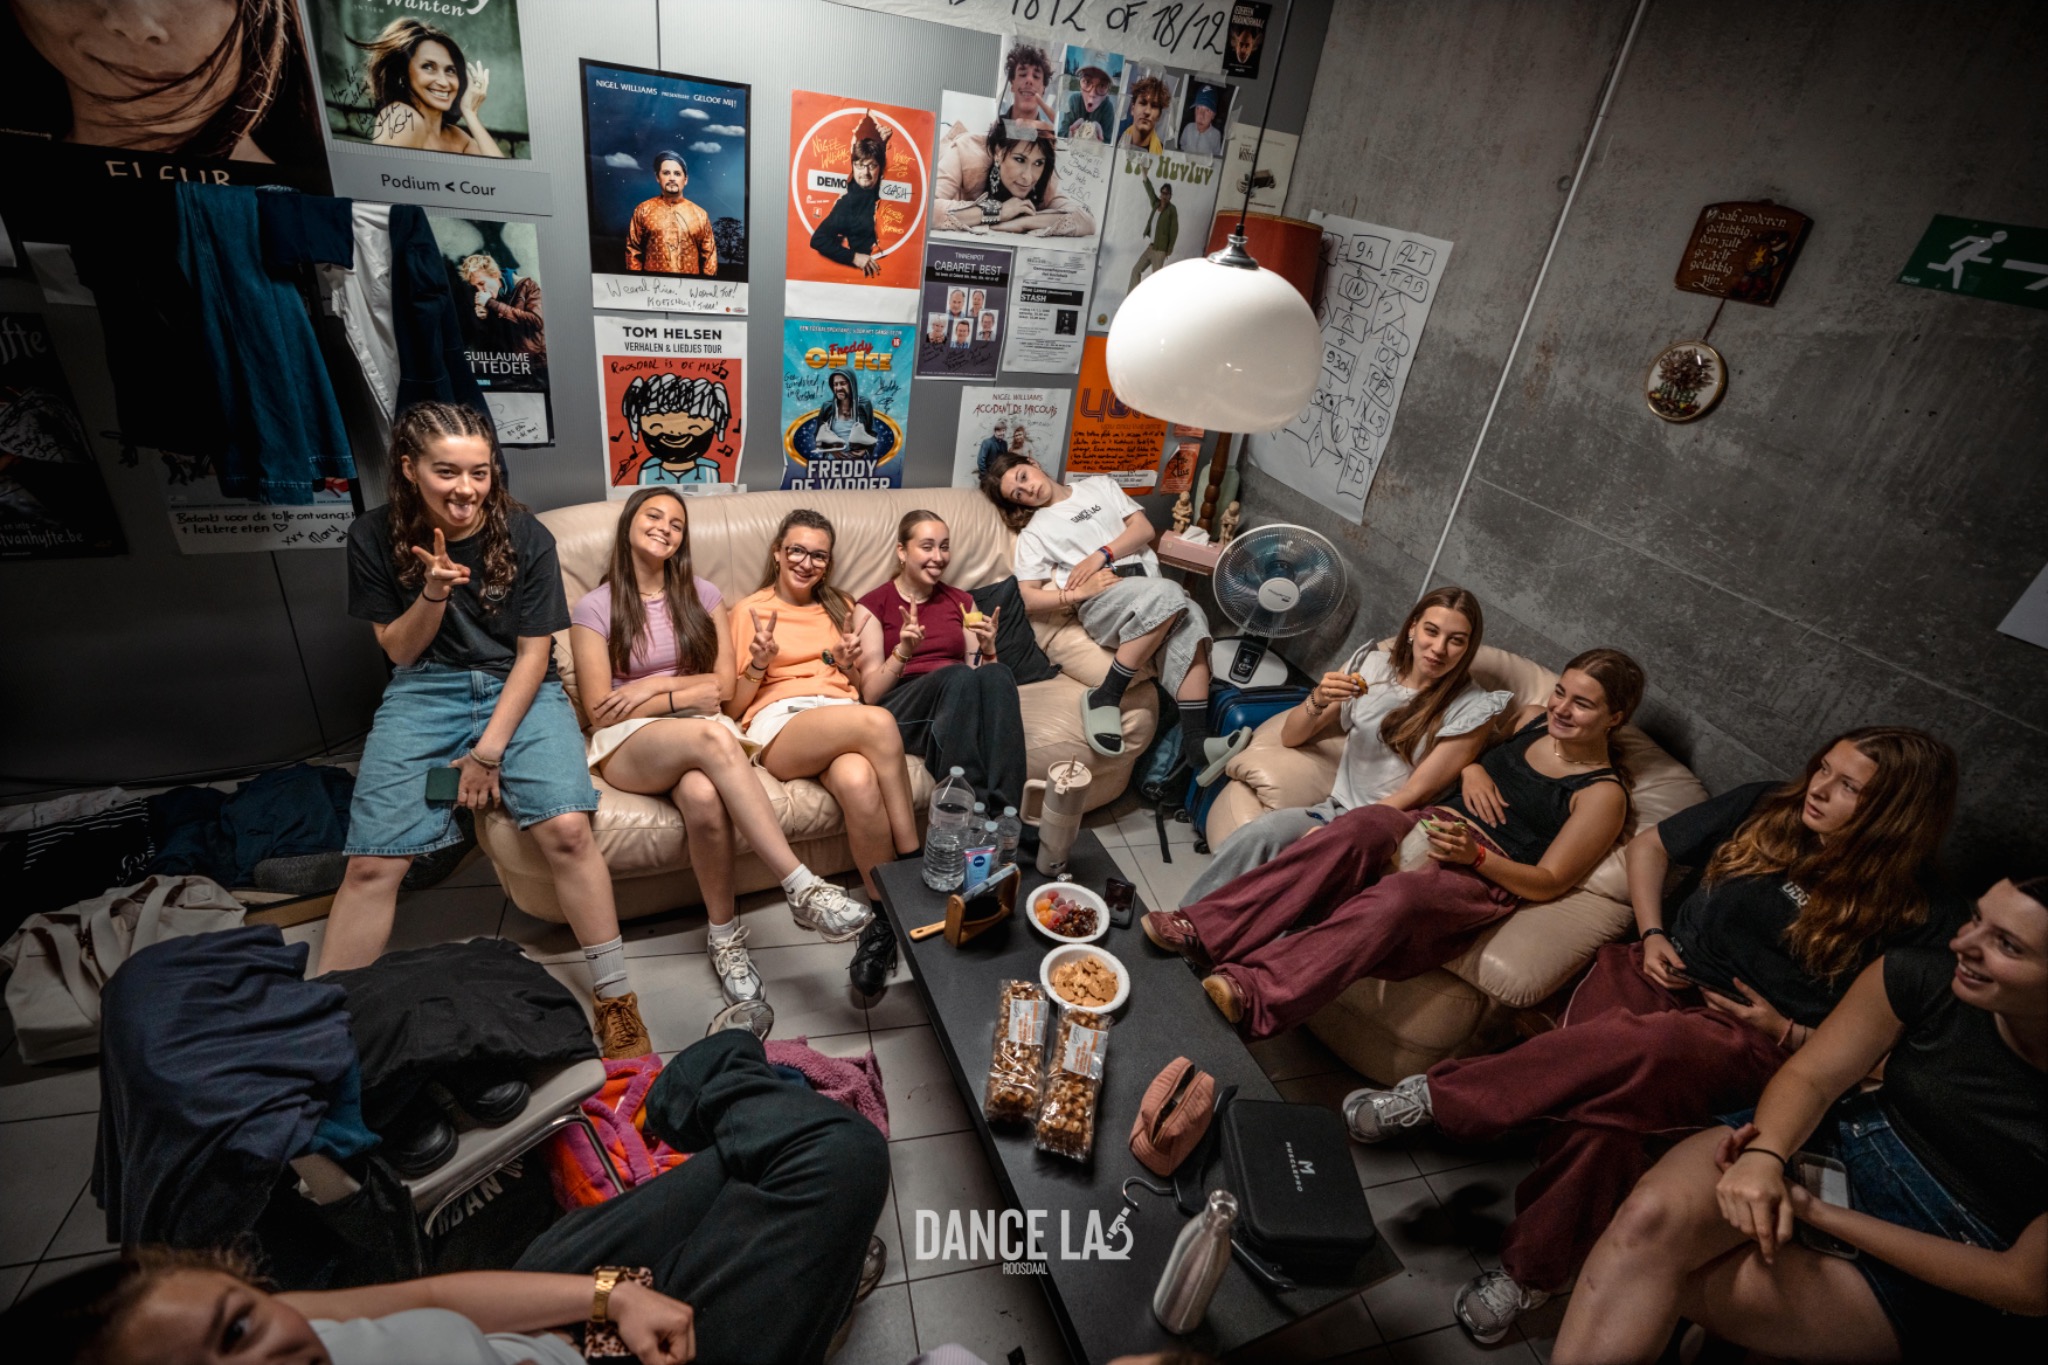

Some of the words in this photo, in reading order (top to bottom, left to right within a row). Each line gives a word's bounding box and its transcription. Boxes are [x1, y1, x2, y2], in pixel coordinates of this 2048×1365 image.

[1106, 1, 1148, 33] OF
[1153, 3, 1225, 55] 18/12
[596, 79, 619, 90] NIGEL
[620, 83, 657, 95] WILLIAMS
[693, 94, 721, 105] GELOOF
[381, 173, 440, 192] Podium
[460, 181, 496, 196] Cour
[817, 176, 847, 188] DEMO
[1741, 213, 1787, 228] anderen
[1397, 243, 1433, 267] ALT
[934, 260, 977, 273] CABARET
[979, 264, 1003, 276] BEST
[1021, 294, 1047, 303] STASH
[623, 326, 657, 338] TOM
[664, 328, 722, 340] HELSEN
[625, 342, 663, 353] VERHALEN
[673, 343, 702, 353] LIEDJES
[703, 344, 722, 353] TOUR
[829, 339, 874, 356] Freddy
[805, 347, 848, 369] ON
[854, 350, 892, 371] ICE
[479, 361, 532, 375] TEDER
[808, 460, 878, 479] FREDDY
[791, 478, 815, 490] DE
[225, 514, 249, 522] voor
[253, 511, 267, 522] de
[1285, 1141, 1303, 1192] MUSCLEPRO
